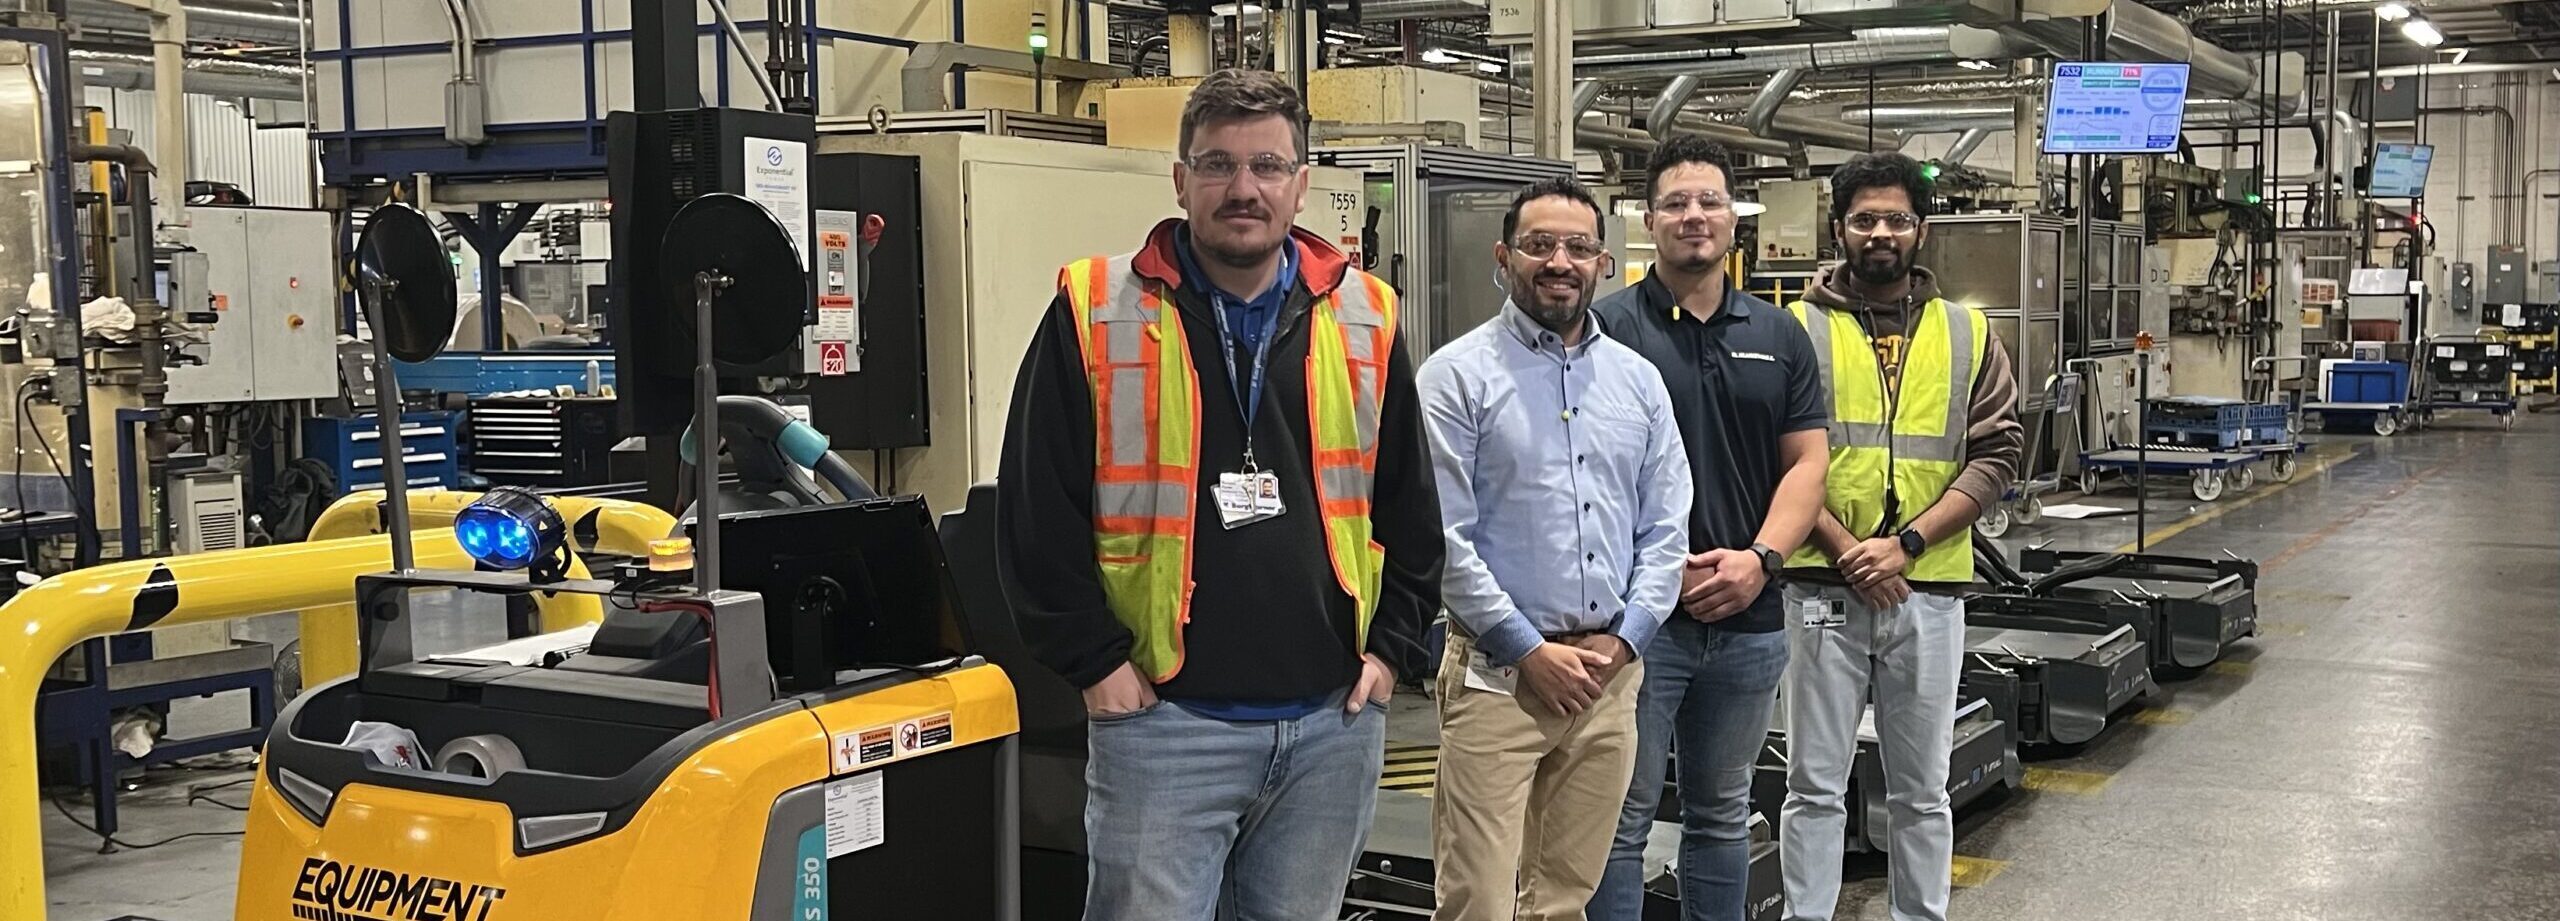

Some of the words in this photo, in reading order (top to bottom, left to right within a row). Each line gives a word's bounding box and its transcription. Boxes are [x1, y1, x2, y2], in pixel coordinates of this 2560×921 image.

[2060, 66, 2081, 76] 7532
[1330, 193, 1356, 210] 7559
[1341, 215, 1348, 232] 5
[804, 857, 821, 901] 350
[292, 857, 506, 921] EQUIPMENT
